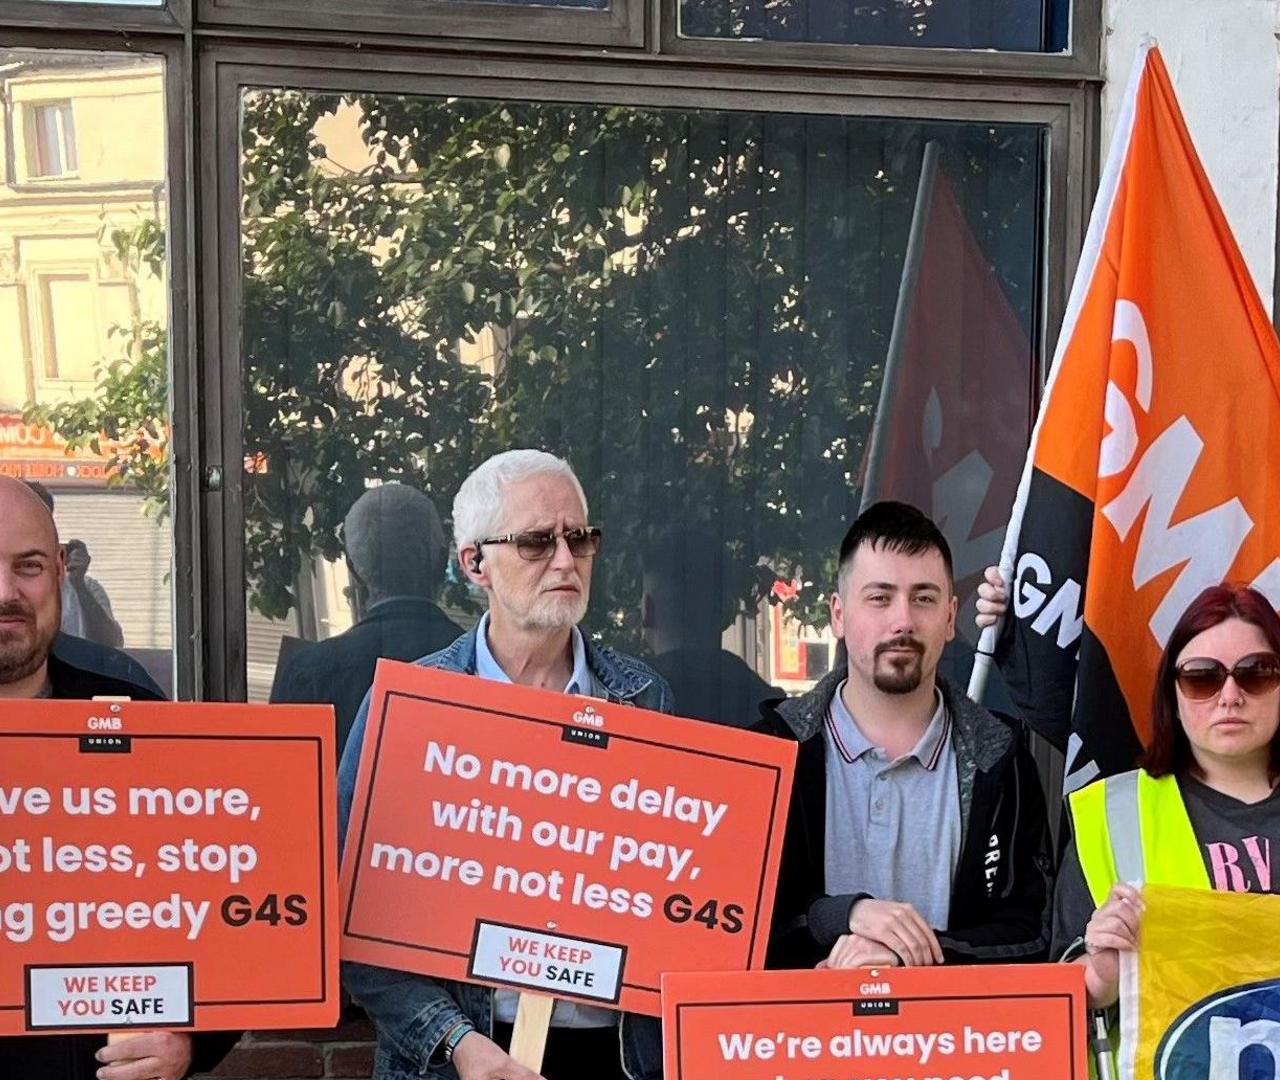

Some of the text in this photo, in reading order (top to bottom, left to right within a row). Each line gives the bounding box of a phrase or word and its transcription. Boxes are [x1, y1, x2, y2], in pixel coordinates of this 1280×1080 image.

[87, 717, 122, 729] GMB
[573, 711, 604, 727] GMB
[571, 730, 600, 740] UNION
[63, 787, 117, 815] us
[129, 786, 261, 822] more,
[424, 741, 729, 836] No more delay
[432, 798, 701, 882] with our pay,
[43, 837, 146, 878] less,
[157, 837, 257, 883] stop
[371, 842, 745, 934] more not less G4S
[46, 894, 211, 942] greedy
[220, 894, 308, 927] G4S
[508, 936, 592, 965] WE KEEP
[64, 975, 157, 993] WE KEEP
[499, 957, 595, 988] YOU SAFE
[860, 983, 891, 995] GMB
[58, 998, 165, 1016] YOU SAFE
[718, 1026, 1043, 1064] We're always here
